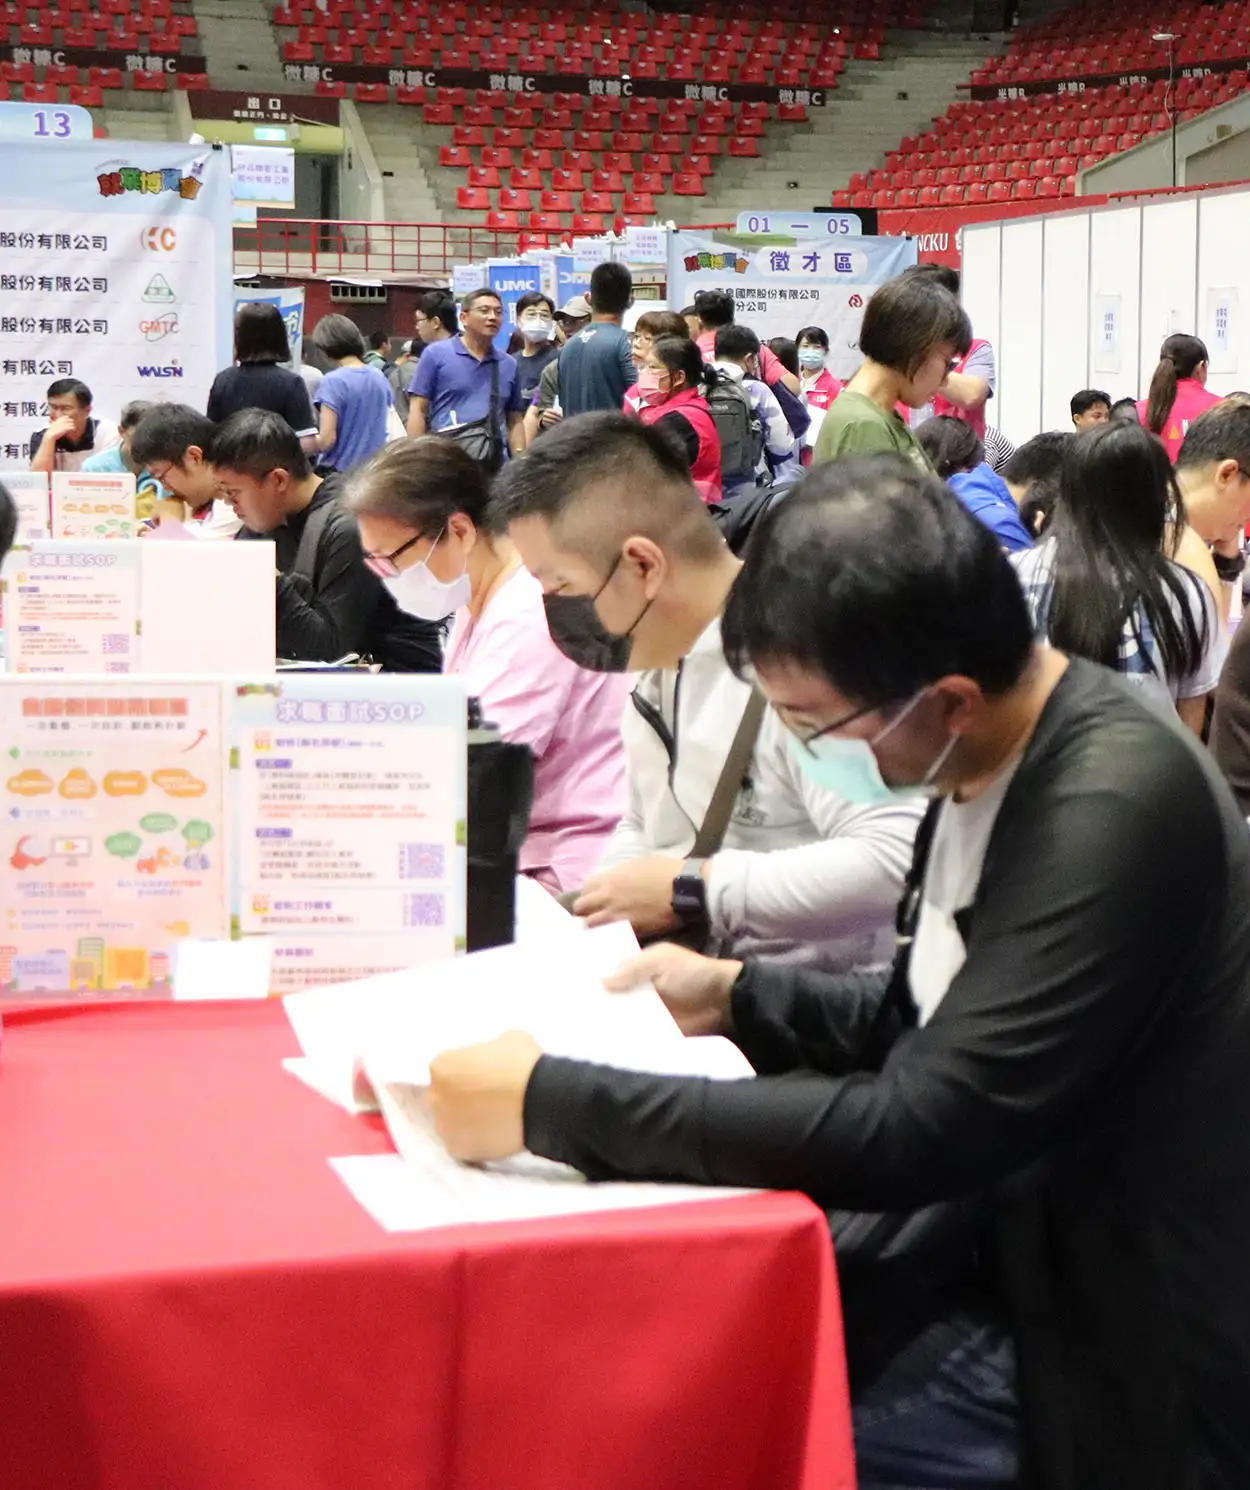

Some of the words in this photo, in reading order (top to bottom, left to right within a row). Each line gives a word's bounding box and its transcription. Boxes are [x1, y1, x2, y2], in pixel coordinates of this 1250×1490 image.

[247, 97, 281, 110] 出口
[34, 112, 71, 137] 13
[748, 217, 771, 233] 01
[827, 219, 850, 234] 05
[0, 232, 108, 251] 股份有限公司
[916, 233, 949, 252] NCKU
[770, 251, 853, 272] 徵才區
[1, 274, 108, 293] 股份有限公司
[495, 280, 536, 292] UMC
[736, 301, 767, 312] 分公司
[0, 317, 108, 335] 股份有限公司
[139, 321, 180, 334] GMTC
[0, 360, 73, 376] 有限公司
[276, 700, 424, 724] 求職面試SOP
